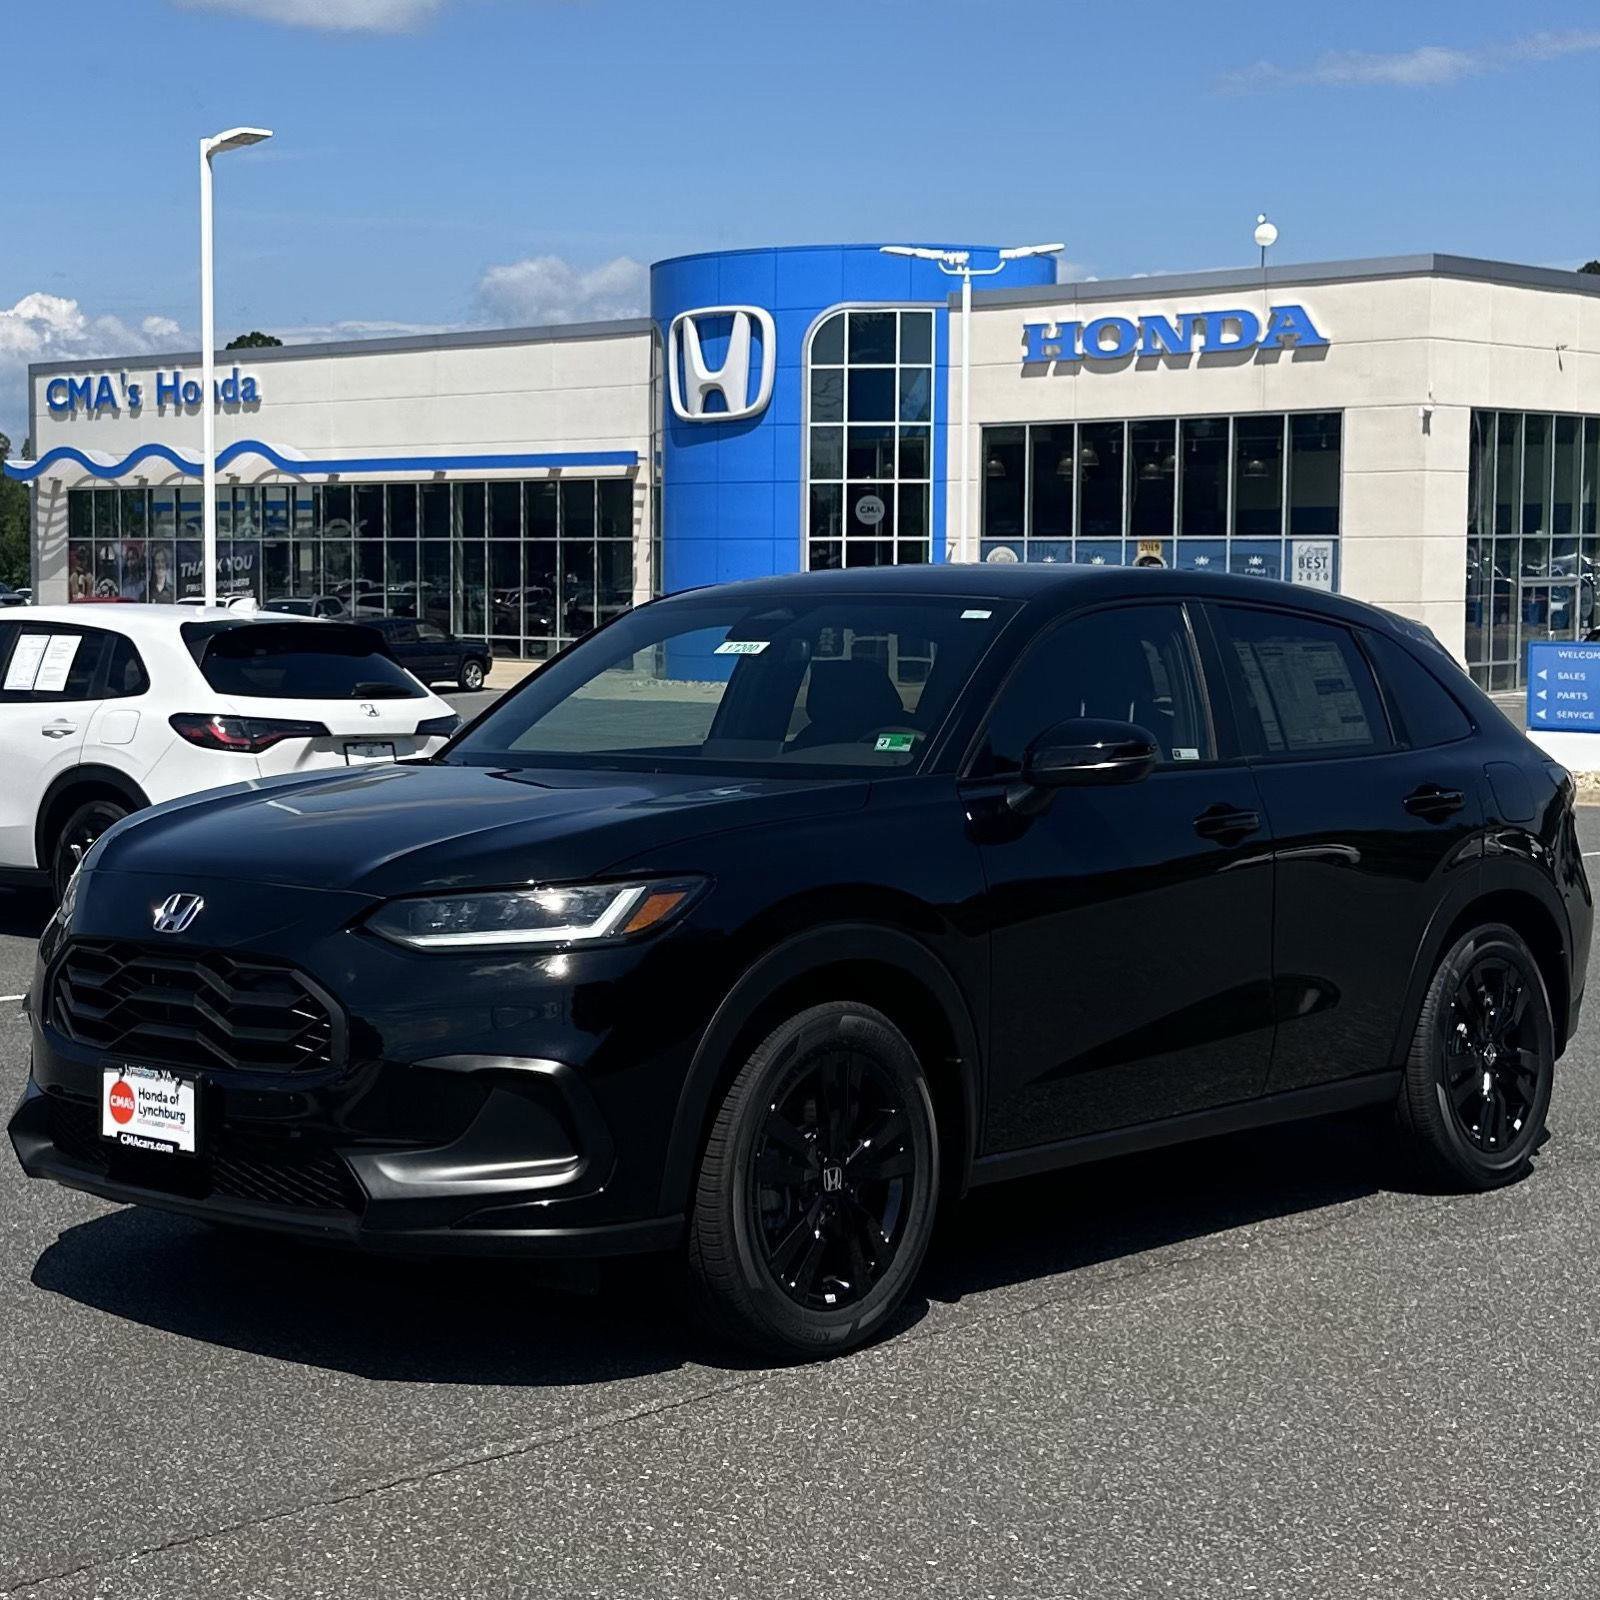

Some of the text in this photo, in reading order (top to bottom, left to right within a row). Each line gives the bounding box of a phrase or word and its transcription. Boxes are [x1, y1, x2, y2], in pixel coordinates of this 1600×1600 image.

[1022, 305, 1331, 363] HONDA
[46, 367, 260, 412] CMA's Hoda
[180, 554, 253, 578] THAK YOU
[1298, 556, 1328, 569] BEST
[1297, 572, 1329, 582] 2020
[1557, 650, 1600, 660] WELCOM
[1557, 672, 1586, 681] SALES
[1556, 691, 1588, 701] PARTS
[1556, 711, 1595, 720] SERVICE
[138, 1087, 180, 1106] Honda of
[138, 1102, 186, 1125] Lynchburg
[120, 1133, 174, 1154] CMAcars.com
